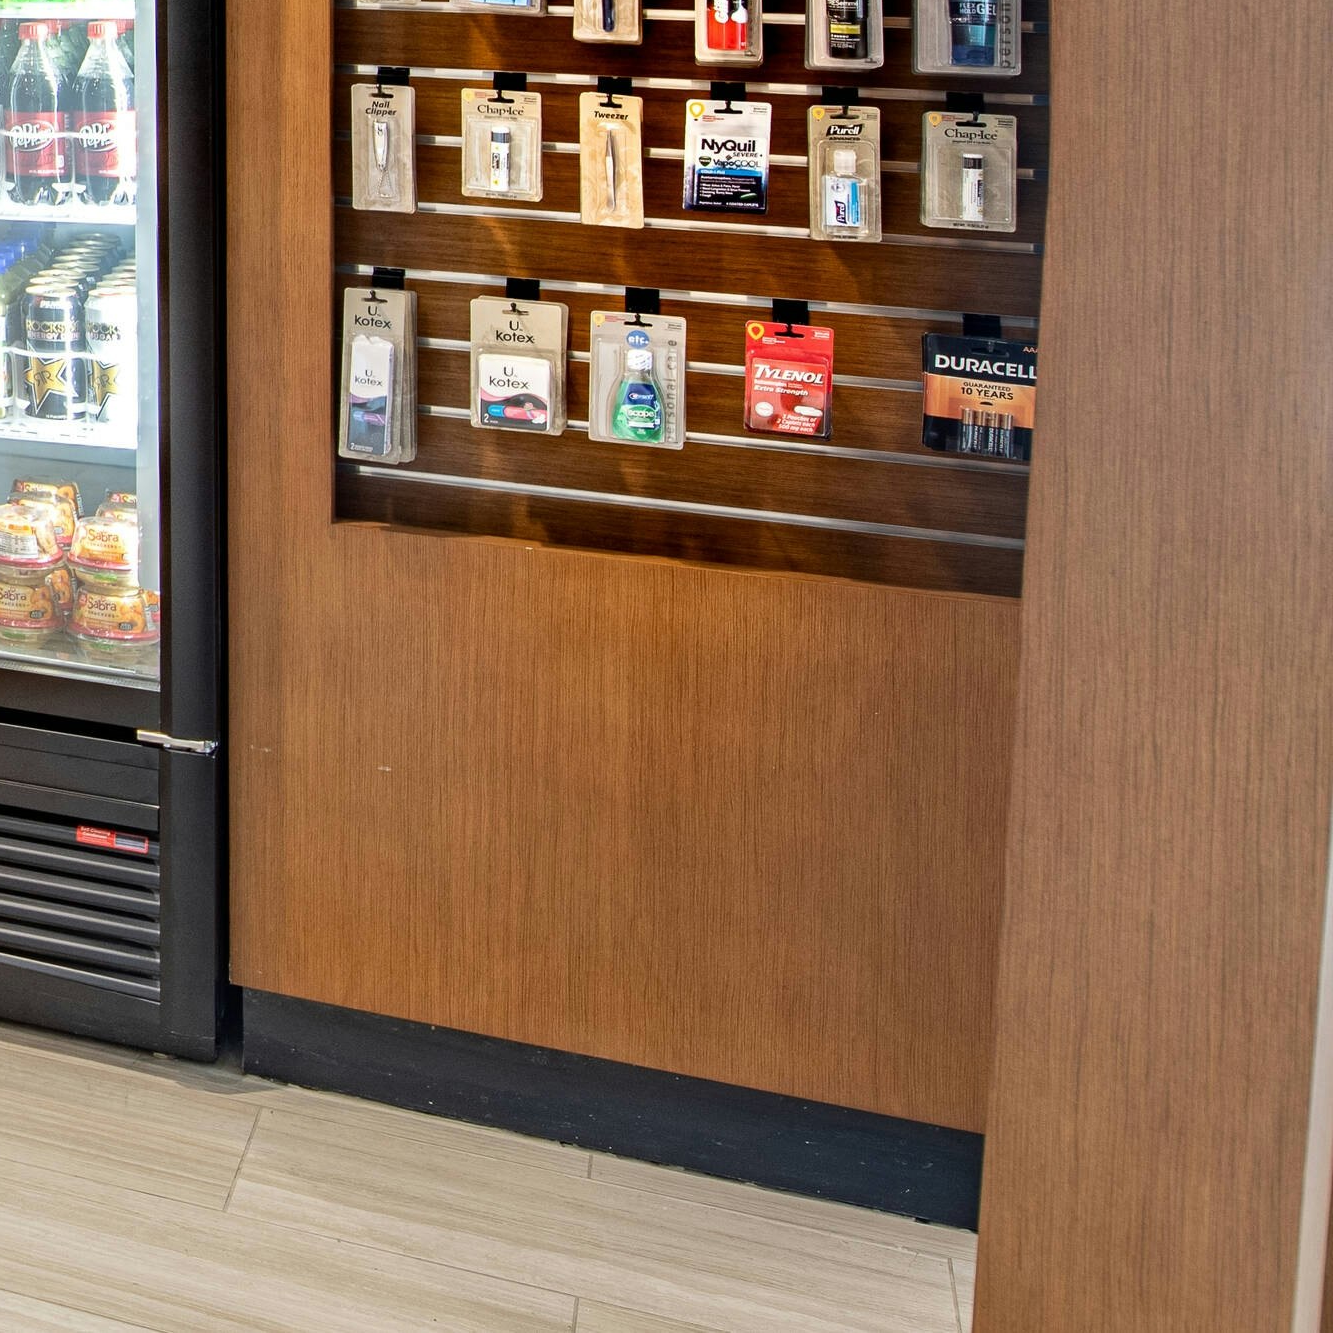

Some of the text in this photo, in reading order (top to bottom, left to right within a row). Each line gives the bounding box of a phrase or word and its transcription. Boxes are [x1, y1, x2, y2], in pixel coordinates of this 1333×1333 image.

[976, 3, 997, 16] GEL
[372, 100, 390, 109] Nail
[365, 107, 398, 117] Clipper
[594, 111, 629, 121] Tweezer
[829, 125, 860, 136] Purell
[701, 138, 756, 155] NyQuil
[712, 159, 759, 169] VapoCOOL
[368, 305, 378, 315] U
[354, 316, 392, 329] kotex
[509, 320, 520, 331] U
[495, 332, 535, 344] kotex
[628, 335, 649, 345] etc.
[503, 367, 514, 377] U
[935, 354, 1037, 379] DURACELL
[364, 369, 373, 377] U
[754, 364, 825, 385] TYLENOL
[354, 376, 383, 387] kotex
[489, 378, 529, 390] kotex
[963, 381, 1012, 392] GUARANTEED
[754, 385, 809, 396] Extra Strength
[961, 387, 1014, 401] 10 YEARS
[483, 413, 489, 423] 2
[627, 408, 656, 419] Scope
[87, 529, 120, 543] Sabra
[87, 595, 118, 612] Sabra
